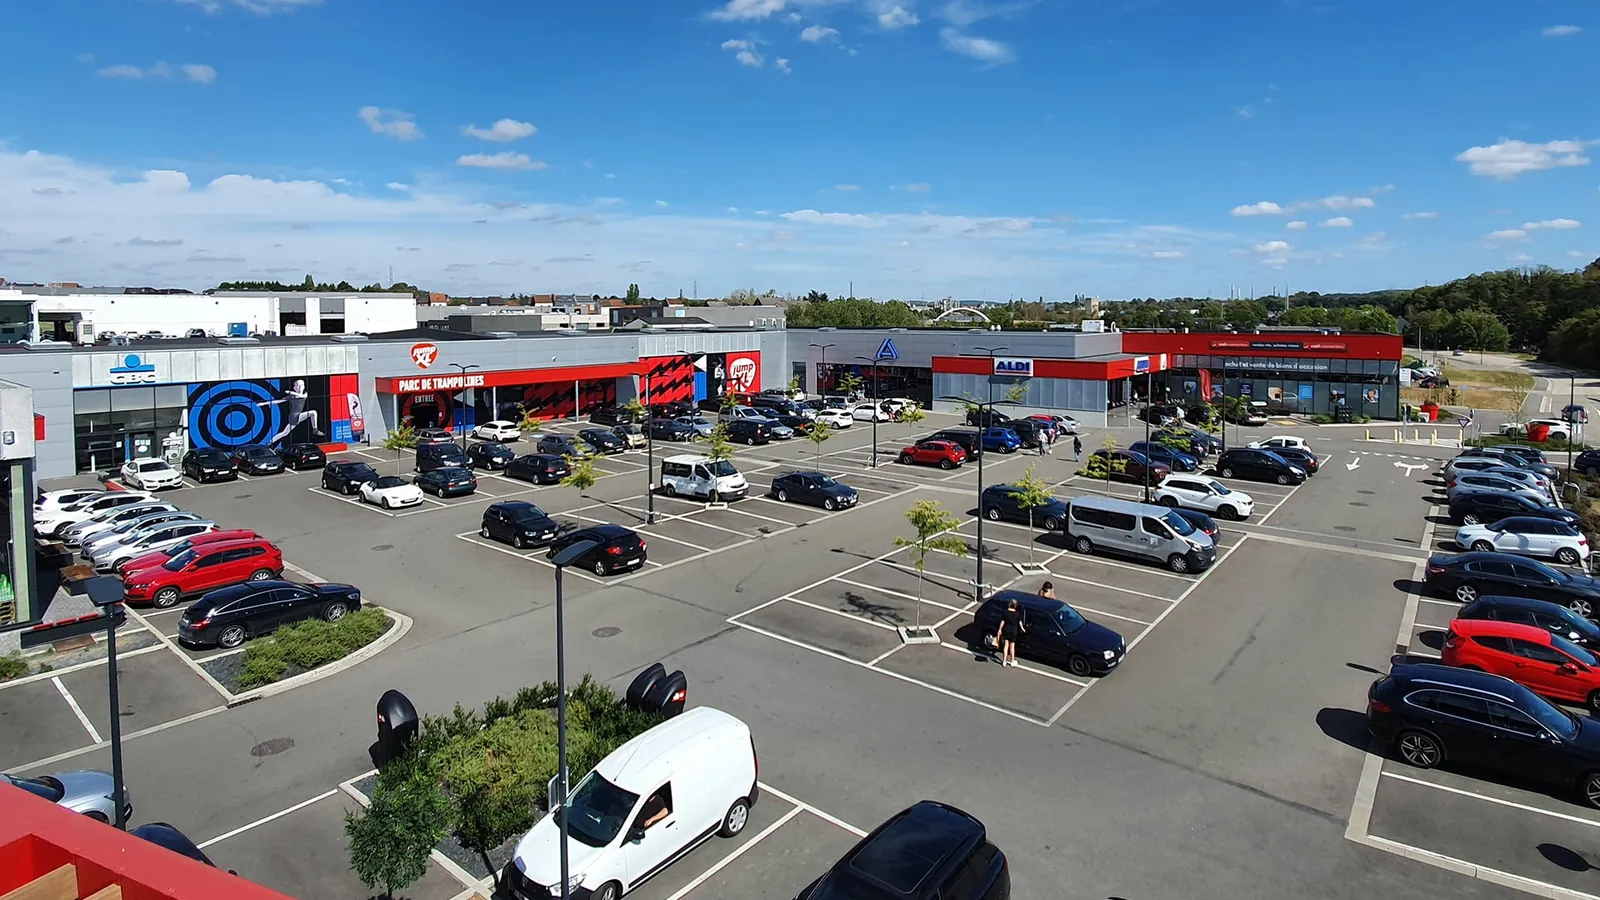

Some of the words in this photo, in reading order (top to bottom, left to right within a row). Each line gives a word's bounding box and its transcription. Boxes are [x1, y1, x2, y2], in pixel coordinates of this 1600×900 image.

[415, 353, 432, 367] XL
[996, 361, 1030, 371] ALDI
[1267, 361, 1275, 369] de
[1293, 362, 1328, 370] doccasion
[110, 373, 156, 385] CBC
[399, 379, 420, 392] PARC
[421, 378, 432, 390] DE
[432, 375, 484, 390] TRAMPOLINES
